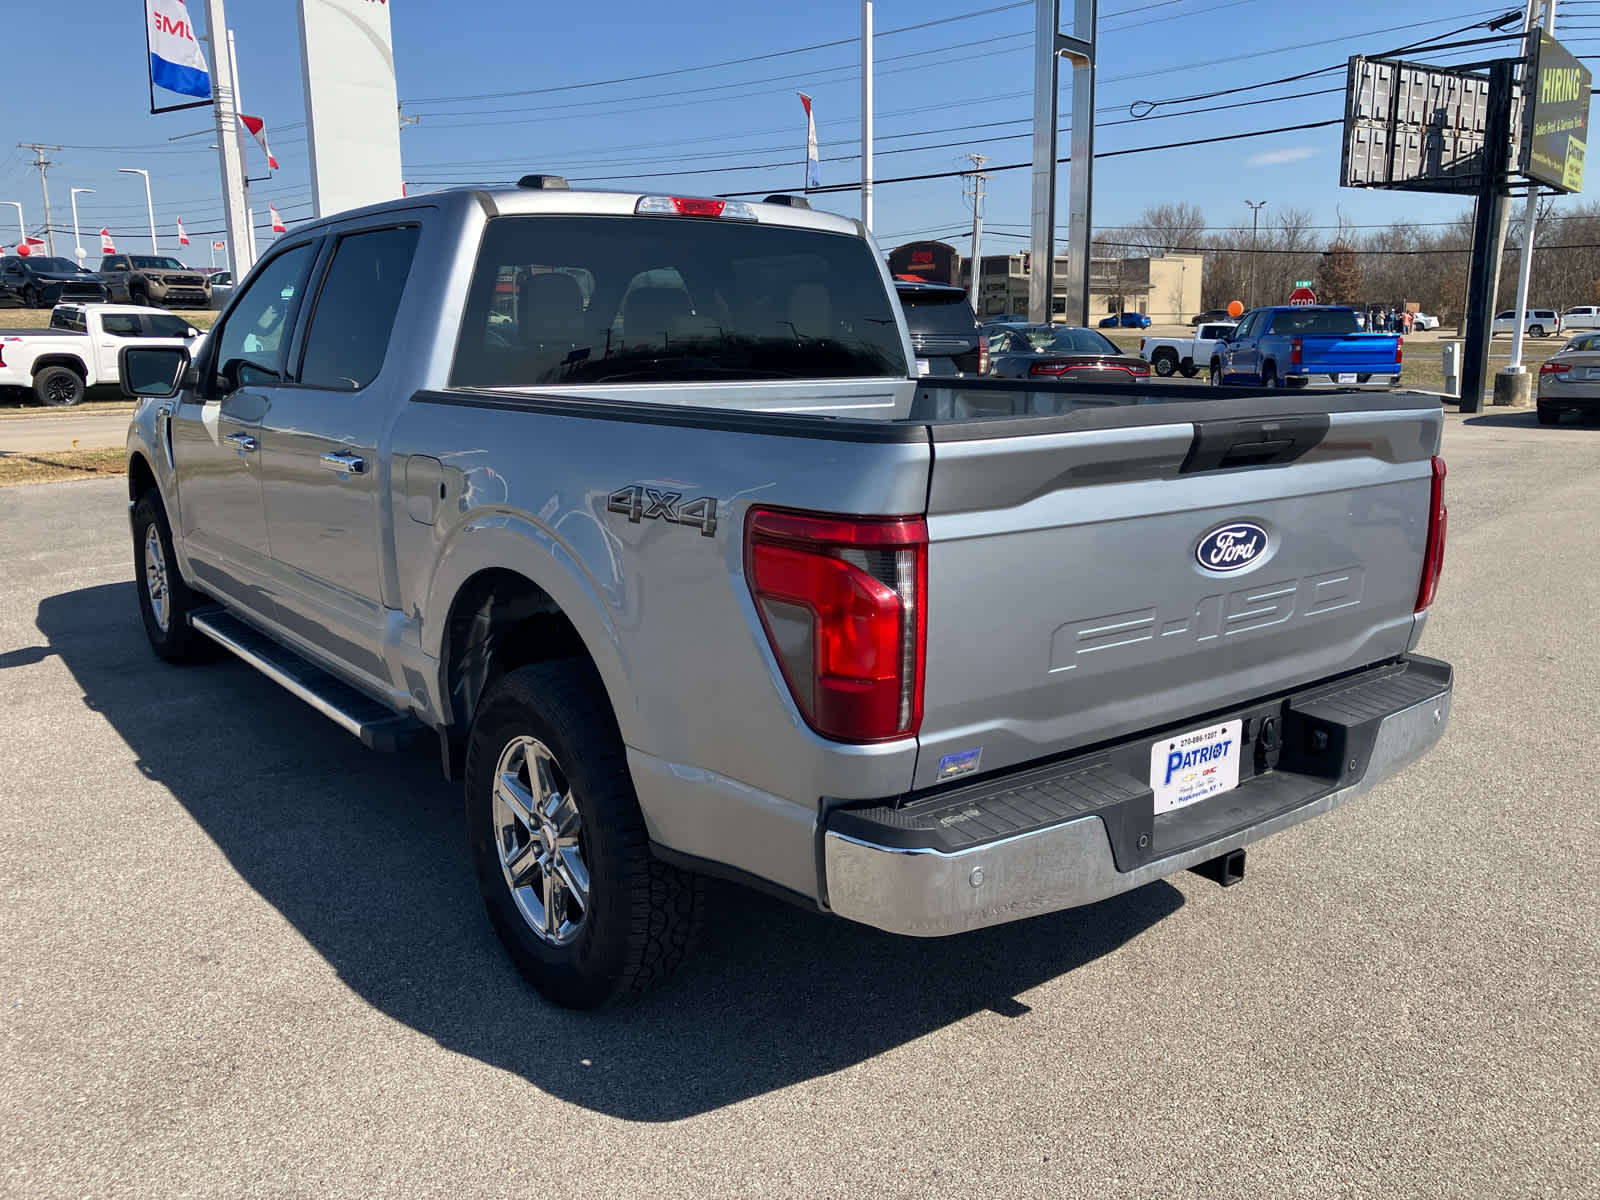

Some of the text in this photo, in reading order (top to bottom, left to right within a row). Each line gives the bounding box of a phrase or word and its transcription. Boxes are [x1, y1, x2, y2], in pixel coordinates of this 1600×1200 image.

[1542, 67, 1581, 104] HIRING
[1210, 530, 1256, 563] Ford
[1049, 565, 1366, 673] F-150
[1164, 740, 1232, 785] PATRIOT
